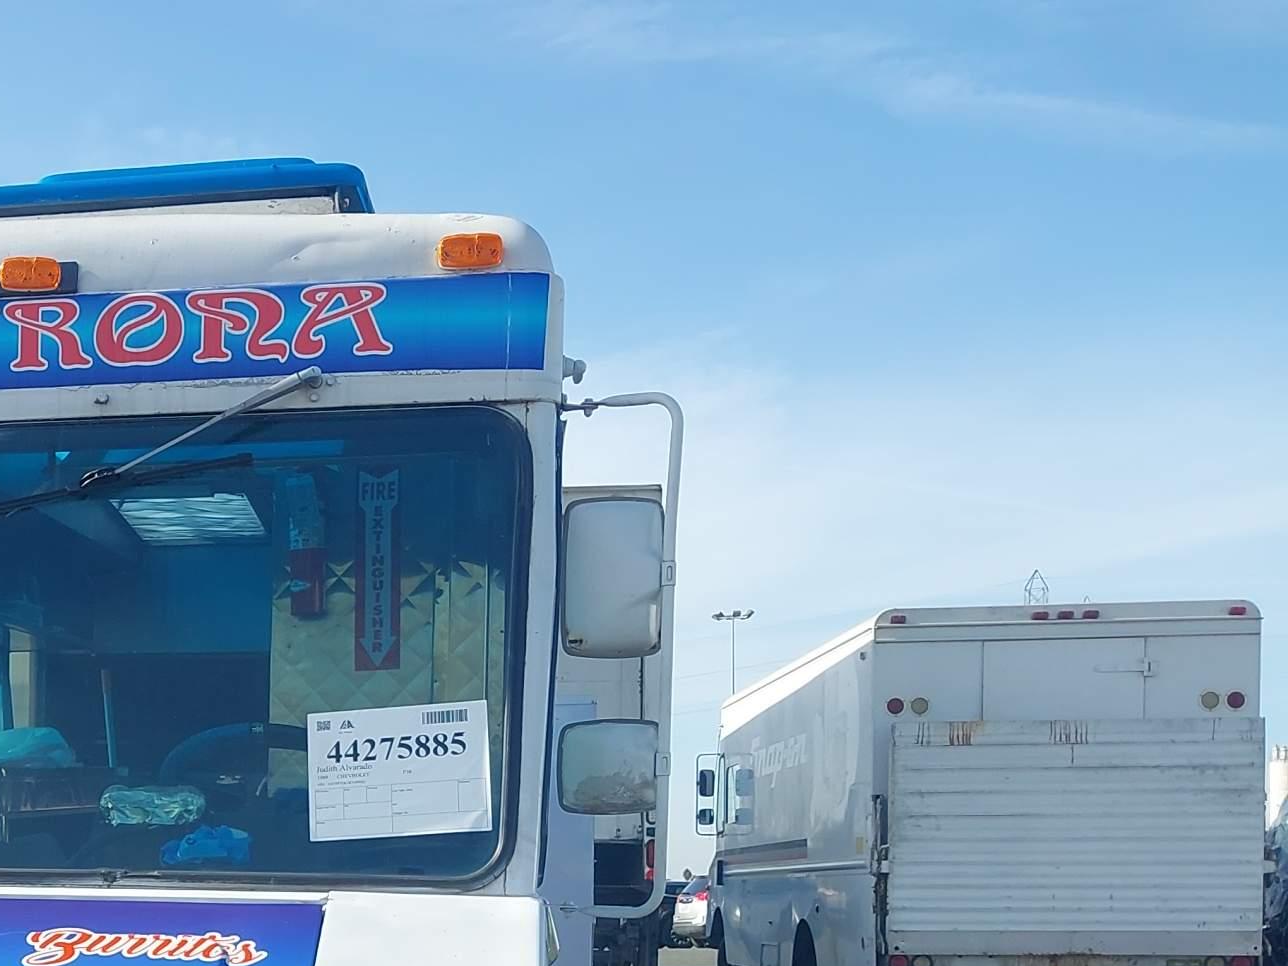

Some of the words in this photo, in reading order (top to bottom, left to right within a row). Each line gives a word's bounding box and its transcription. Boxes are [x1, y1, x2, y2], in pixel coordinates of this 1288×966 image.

[360, 480, 397, 502] FIRE
[371, 505, 386, 653] EXTINGUISHER
[326, 731, 467, 764] 44275885
[316, 764, 338, 774] Judith
